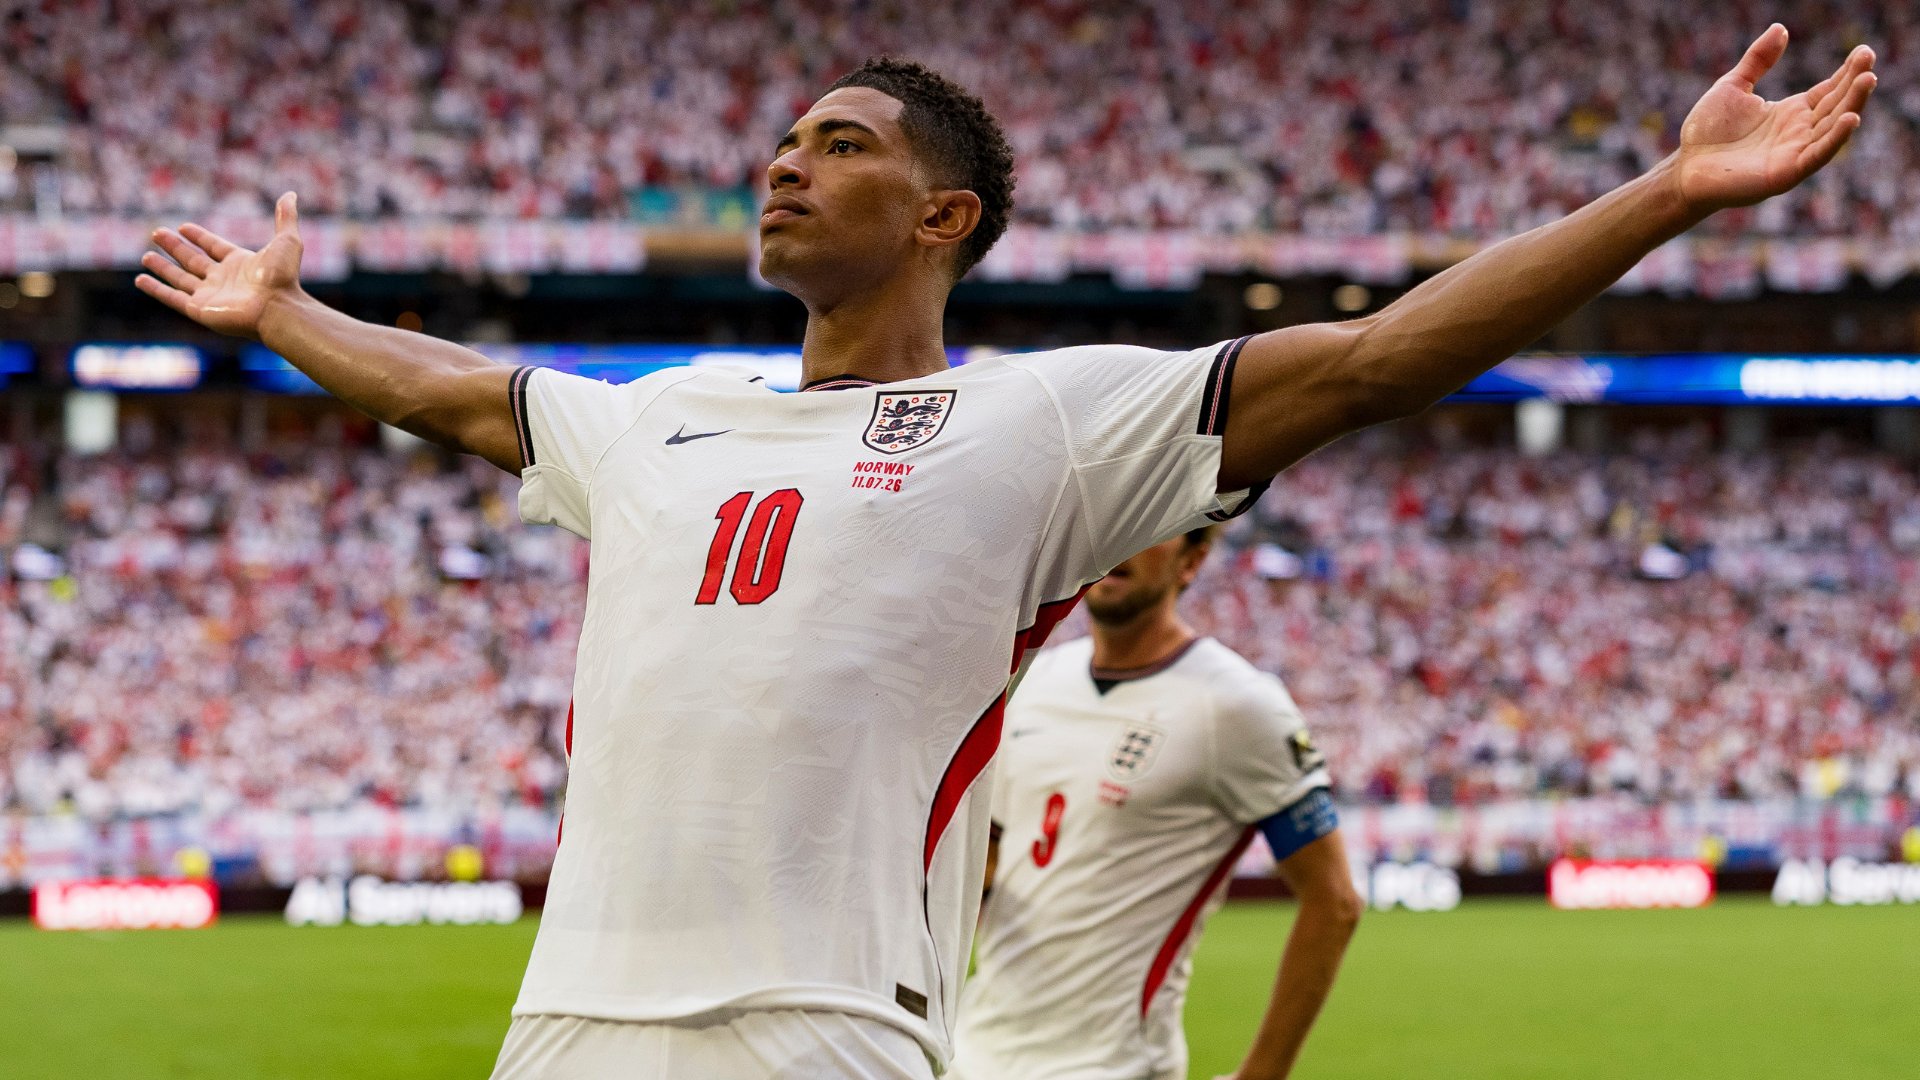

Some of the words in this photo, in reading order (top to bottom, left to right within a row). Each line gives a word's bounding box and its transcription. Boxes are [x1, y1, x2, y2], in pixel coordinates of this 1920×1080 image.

[851, 475, 903, 493] 11.07.26
[853, 461, 915, 476] NORWAY
[694, 488, 804, 605] 10
[1031, 792, 1067, 869] 9
[37, 880, 213, 928] Lenovo
[286, 878, 347, 926] AI
[349, 876, 522, 926] Servers
[1552, 858, 1712, 908] Lenovo
[1773, 859, 1825, 905] AI
